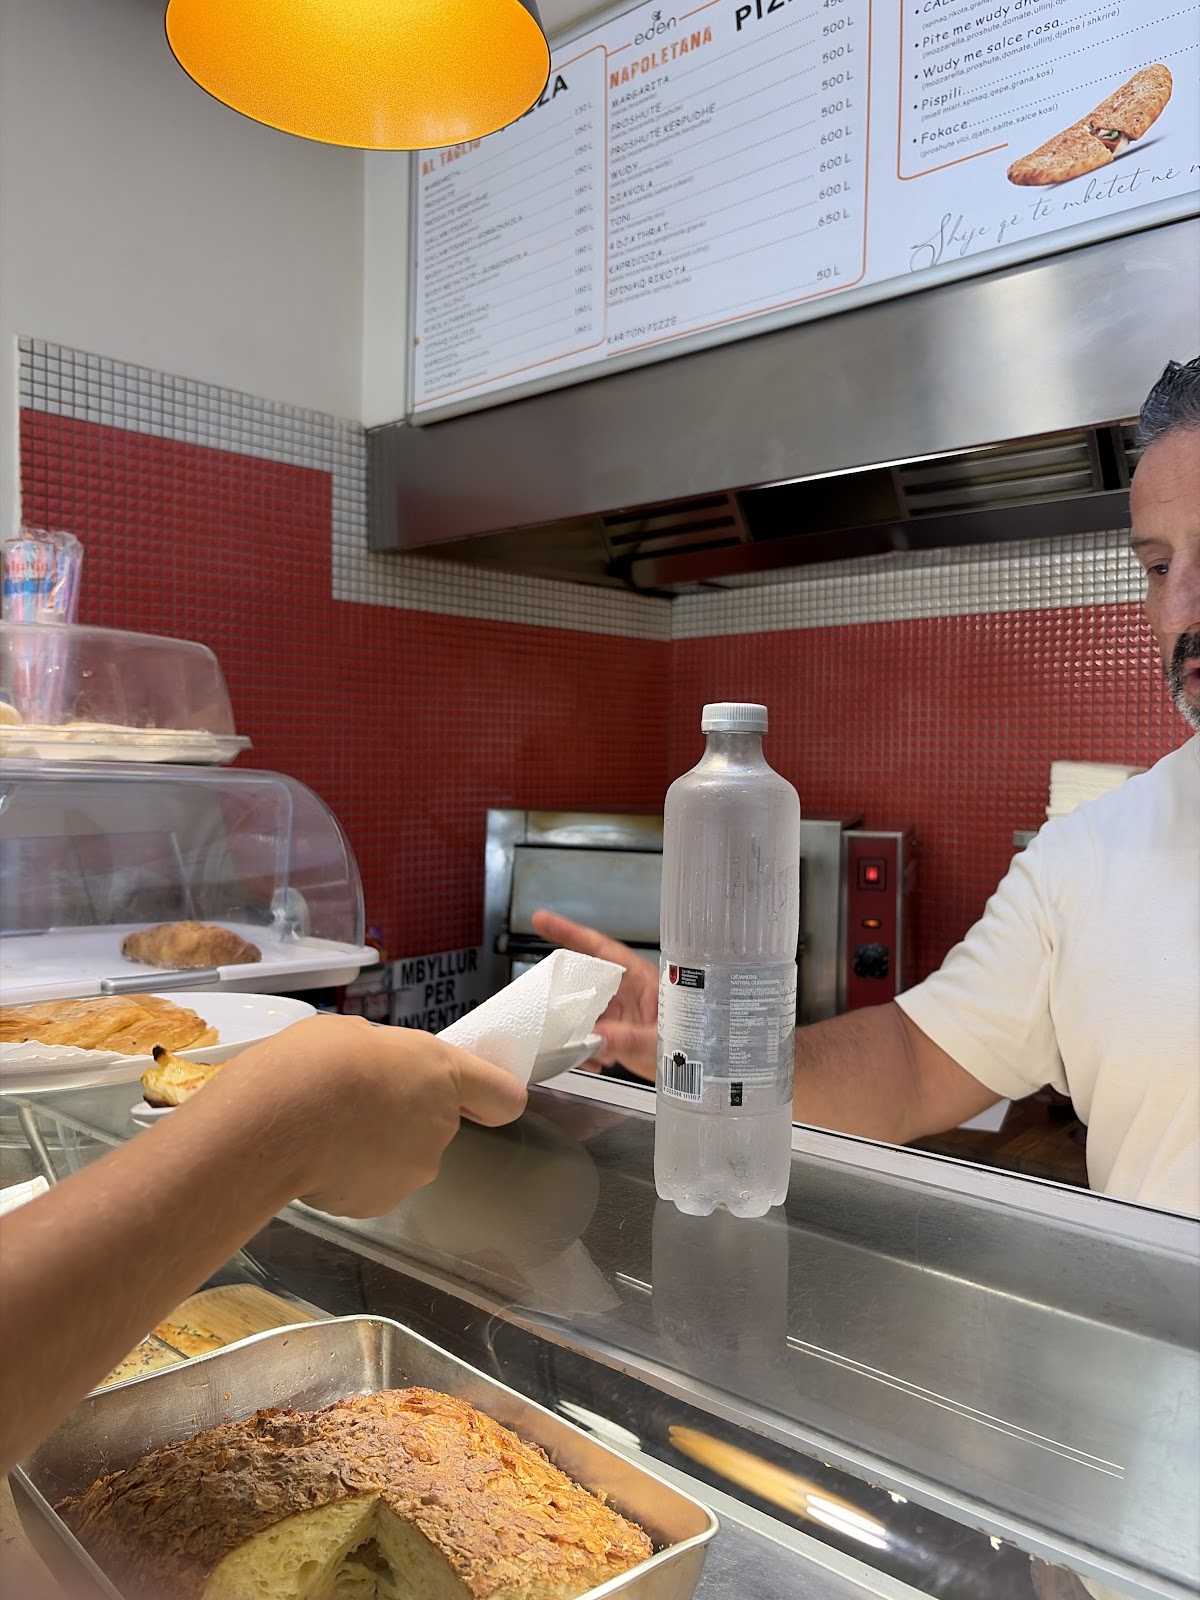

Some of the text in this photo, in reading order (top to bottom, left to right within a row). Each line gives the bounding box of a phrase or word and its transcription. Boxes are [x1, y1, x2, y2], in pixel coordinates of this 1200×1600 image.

[736, 0, 792, 31] PIZ
[823, 0, 844, 8] 45
[923, 0, 956, 13] CAL
[634, 16, 677, 46] eden
[922, 0, 1040, 48] Pite me wudy dh
[609, 25, 714, 90] NAPOLETANA
[922, 19, 1060, 79] Wudy me salce rosa
[609, 102, 662, 132] PROSHUTE
[822, 19, 845, 37] 500
[847, 16, 854, 26] L
[821, 73, 844, 91] 500
[846, 70, 853, 81] L
[609, 127, 662, 156] PROSHUTE
[822, 46, 844, 64] 500
[846, 43, 854, 53] L
[610, 75, 669, 108] MARGARITA
[921, 86, 963, 110] Pispili
[820, 101, 843, 118] 500
[845, 97, 853, 108] L
[820, 128, 843, 145] 600
[844, 125, 852, 136] L
[921, 120, 969, 145] Fokace
[819, 156, 842, 172] 600
[844, 152, 851, 164] L
[818, 183, 842, 200] 600
[843, 180, 851, 191] L
[1063, 167, 1151, 210] mbetet
[1151, 168, 1181, 183] në
[818, 211, 840, 227] 650
[842, 207, 850, 219] L
[816, 267, 832, 281] 50
[833, 265, 840, 276] L
[402, 948, 478, 986] MBYLLUR
[424, 980, 455, 1008] PER
[397, 999, 478, 1032] NVENT
